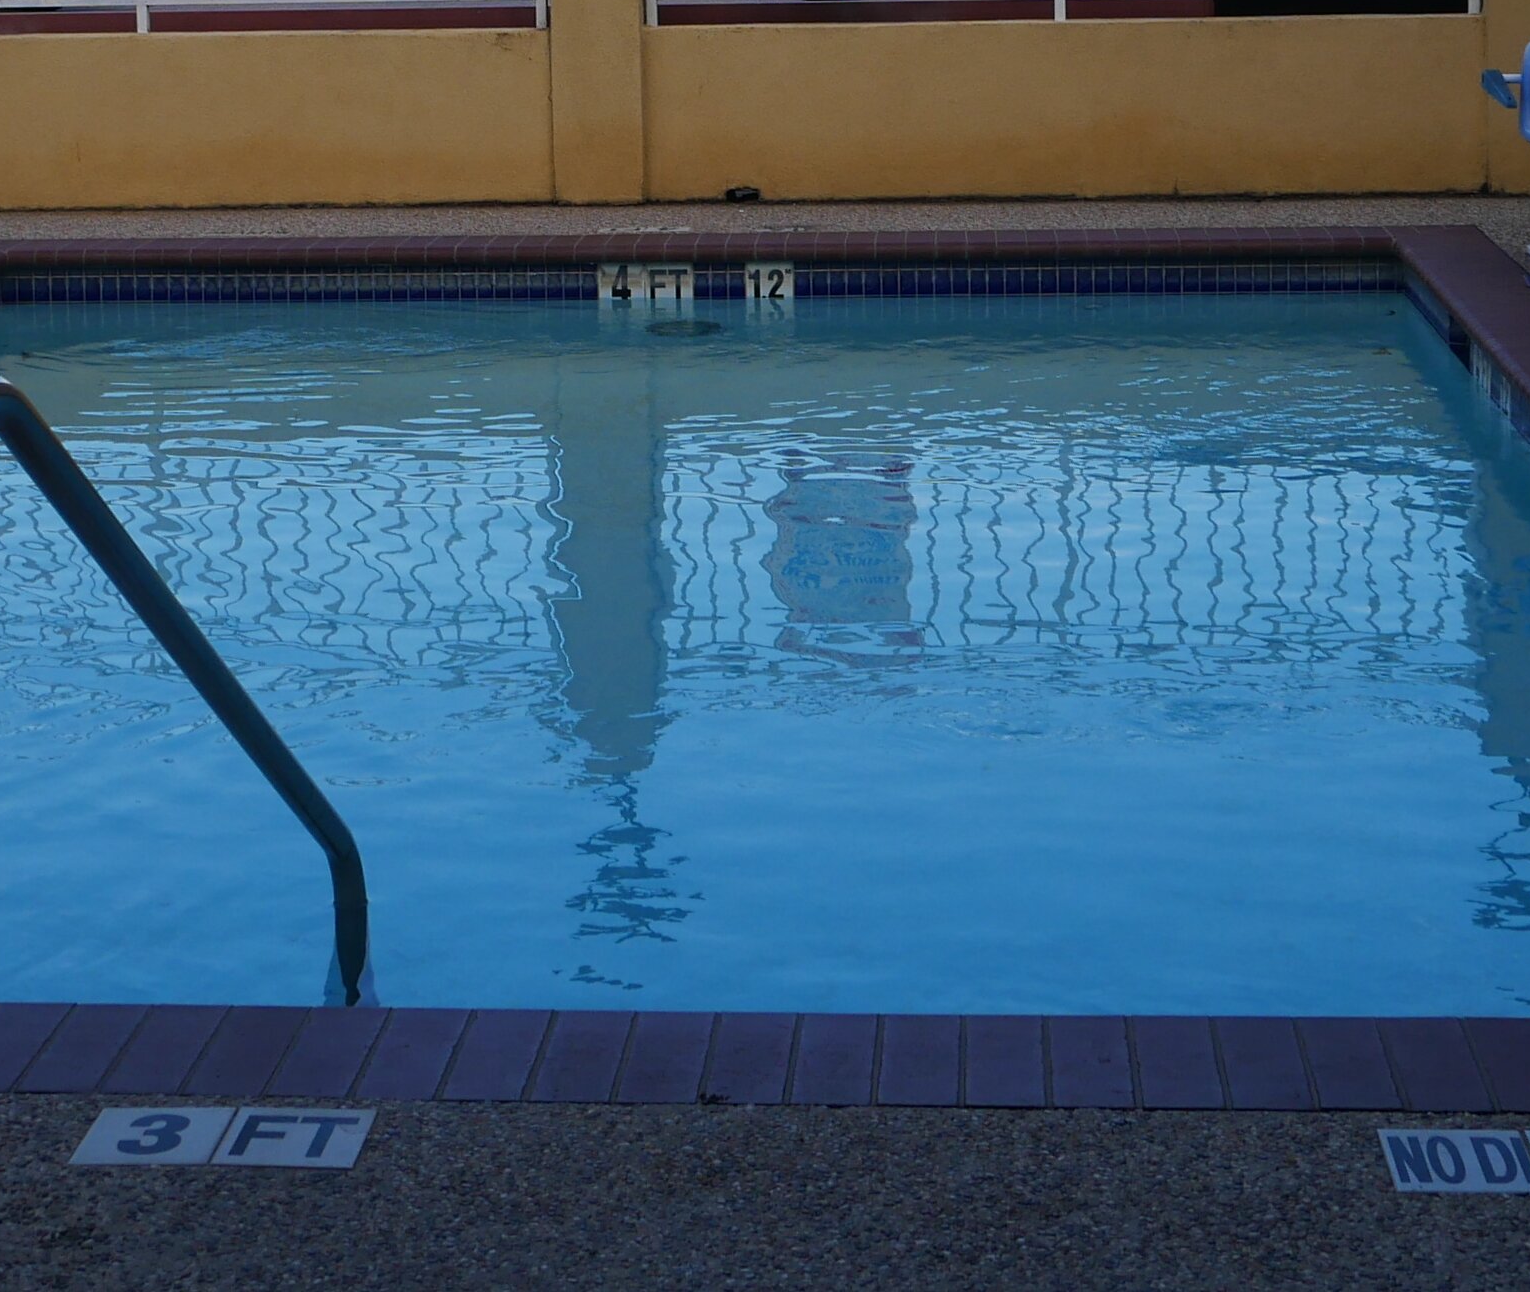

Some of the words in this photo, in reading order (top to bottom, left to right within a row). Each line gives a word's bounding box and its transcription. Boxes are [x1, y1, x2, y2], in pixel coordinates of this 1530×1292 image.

[612, 264, 631, 299] 4
[650, 269, 687, 299] FT
[116, 1114, 192, 1155] 3
[228, 1116, 360, 1159] FT
[1387, 1136, 1467, 1184] NO
